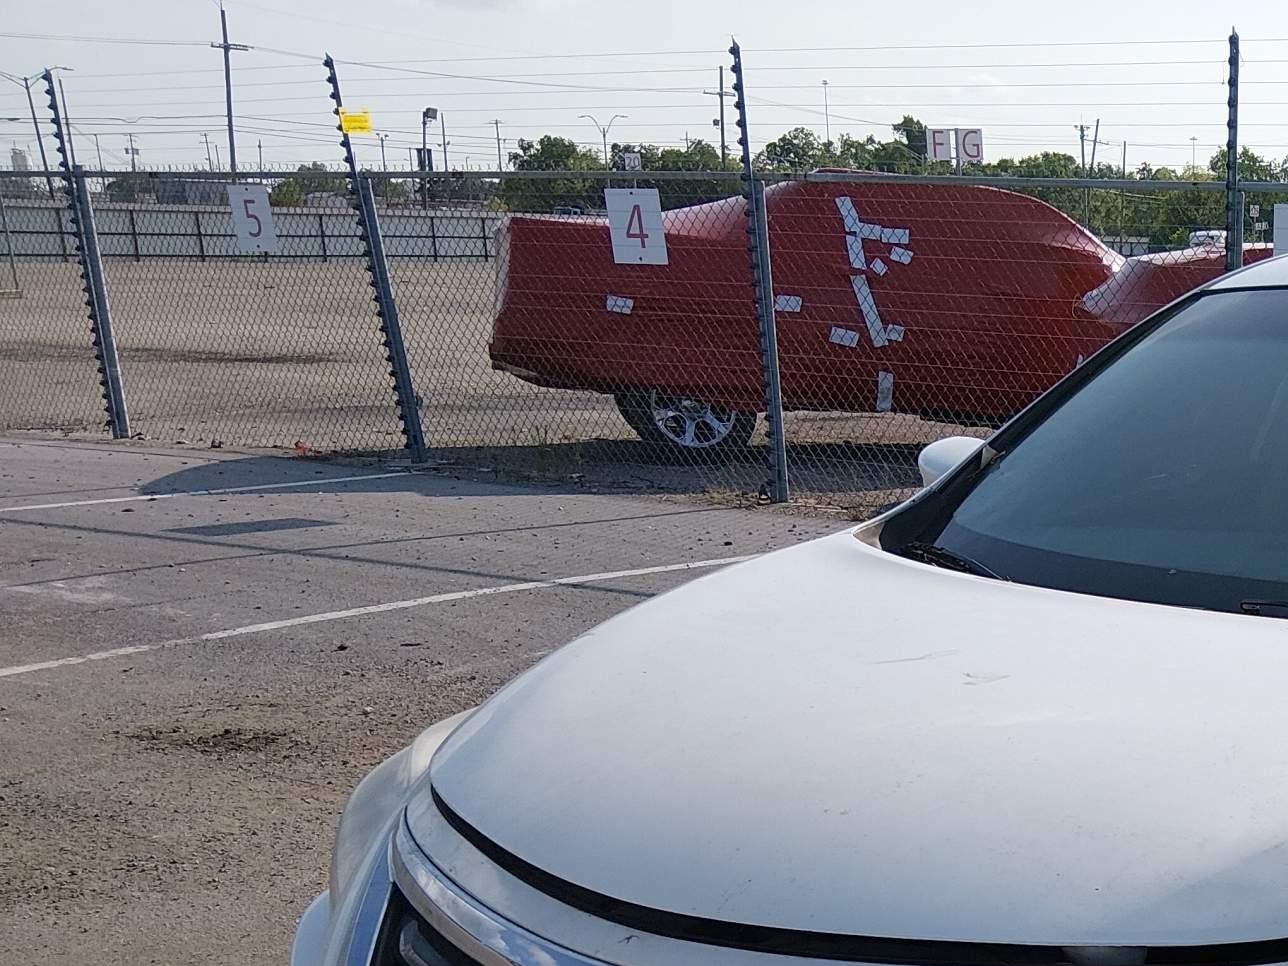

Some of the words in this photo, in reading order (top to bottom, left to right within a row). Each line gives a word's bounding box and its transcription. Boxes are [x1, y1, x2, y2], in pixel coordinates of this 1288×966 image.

[932, 130, 945, 159] F
[962, 130, 980, 159] G
[243, 199, 262, 238] 5
[626, 204, 649, 249] 4
